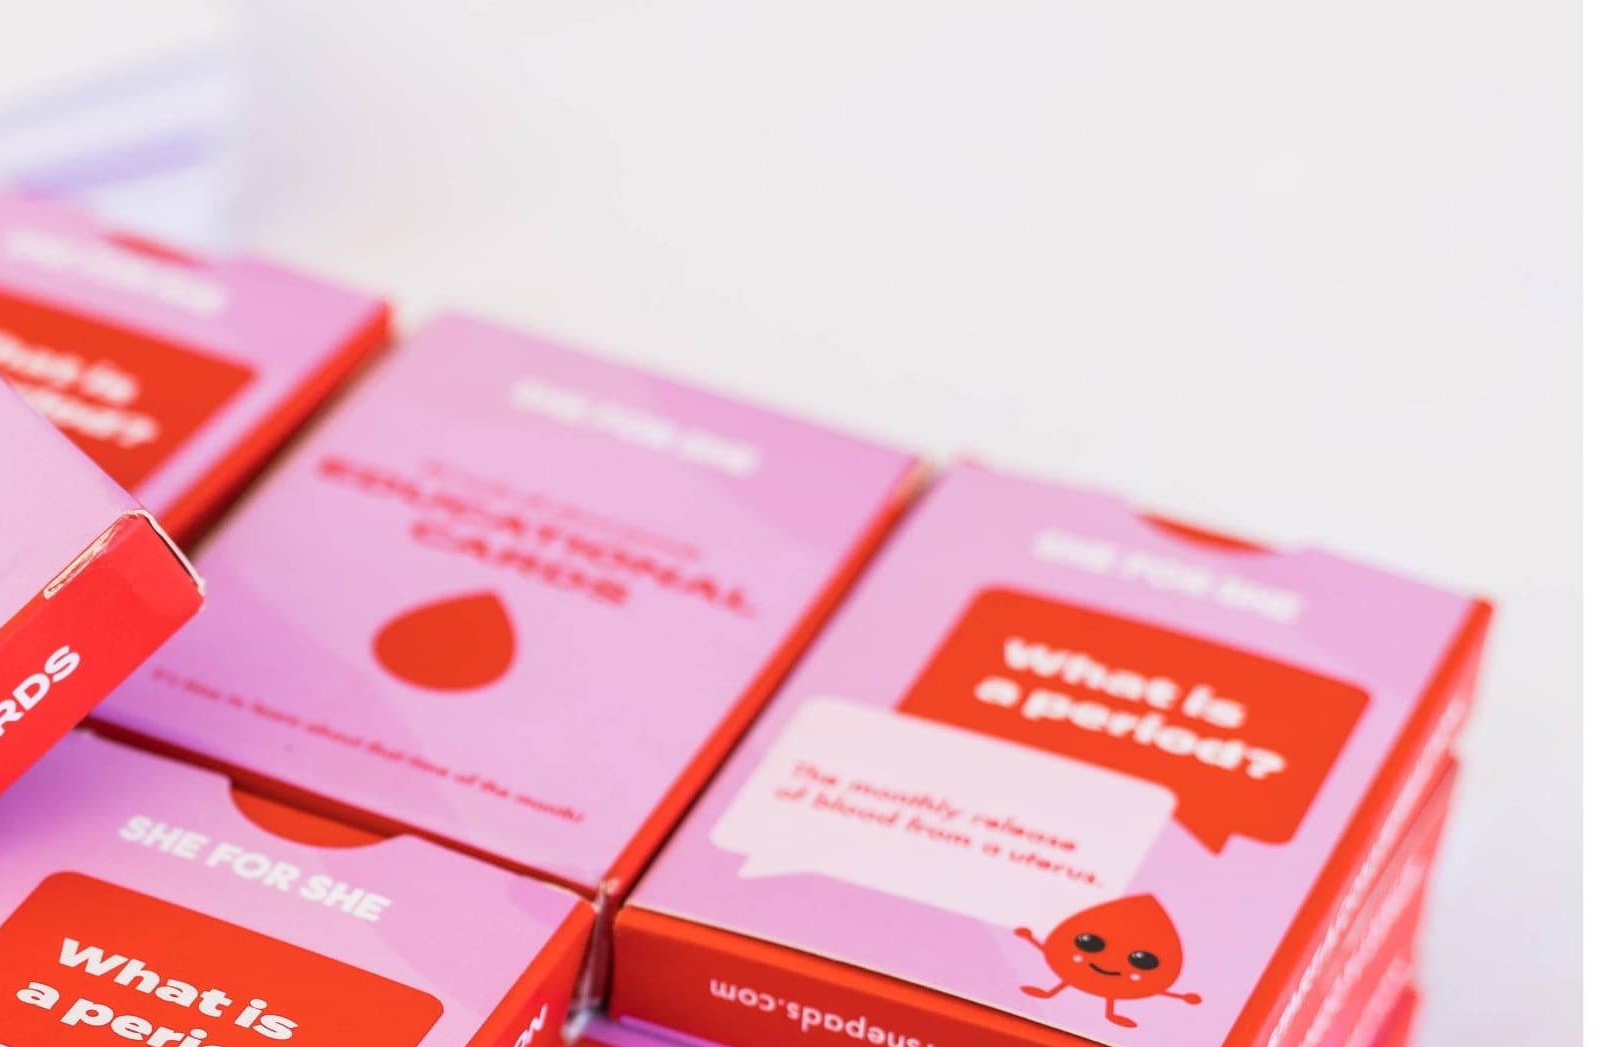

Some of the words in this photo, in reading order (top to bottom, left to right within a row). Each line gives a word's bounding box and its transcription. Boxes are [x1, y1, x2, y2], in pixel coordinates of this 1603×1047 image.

[973, 676, 1021, 707] a
[1020, 688, 1287, 779] period?
[1004, 637, 1179, 709] What
[1181, 684, 1244, 728] is
[118, 815, 209, 861] SHE
[205, 842, 299, 892] FOR
[300, 874, 391, 923] SHE
[16, 981, 60, 1010] a
[59, 937, 233, 1017] What
[234, 998, 298, 1040] is
